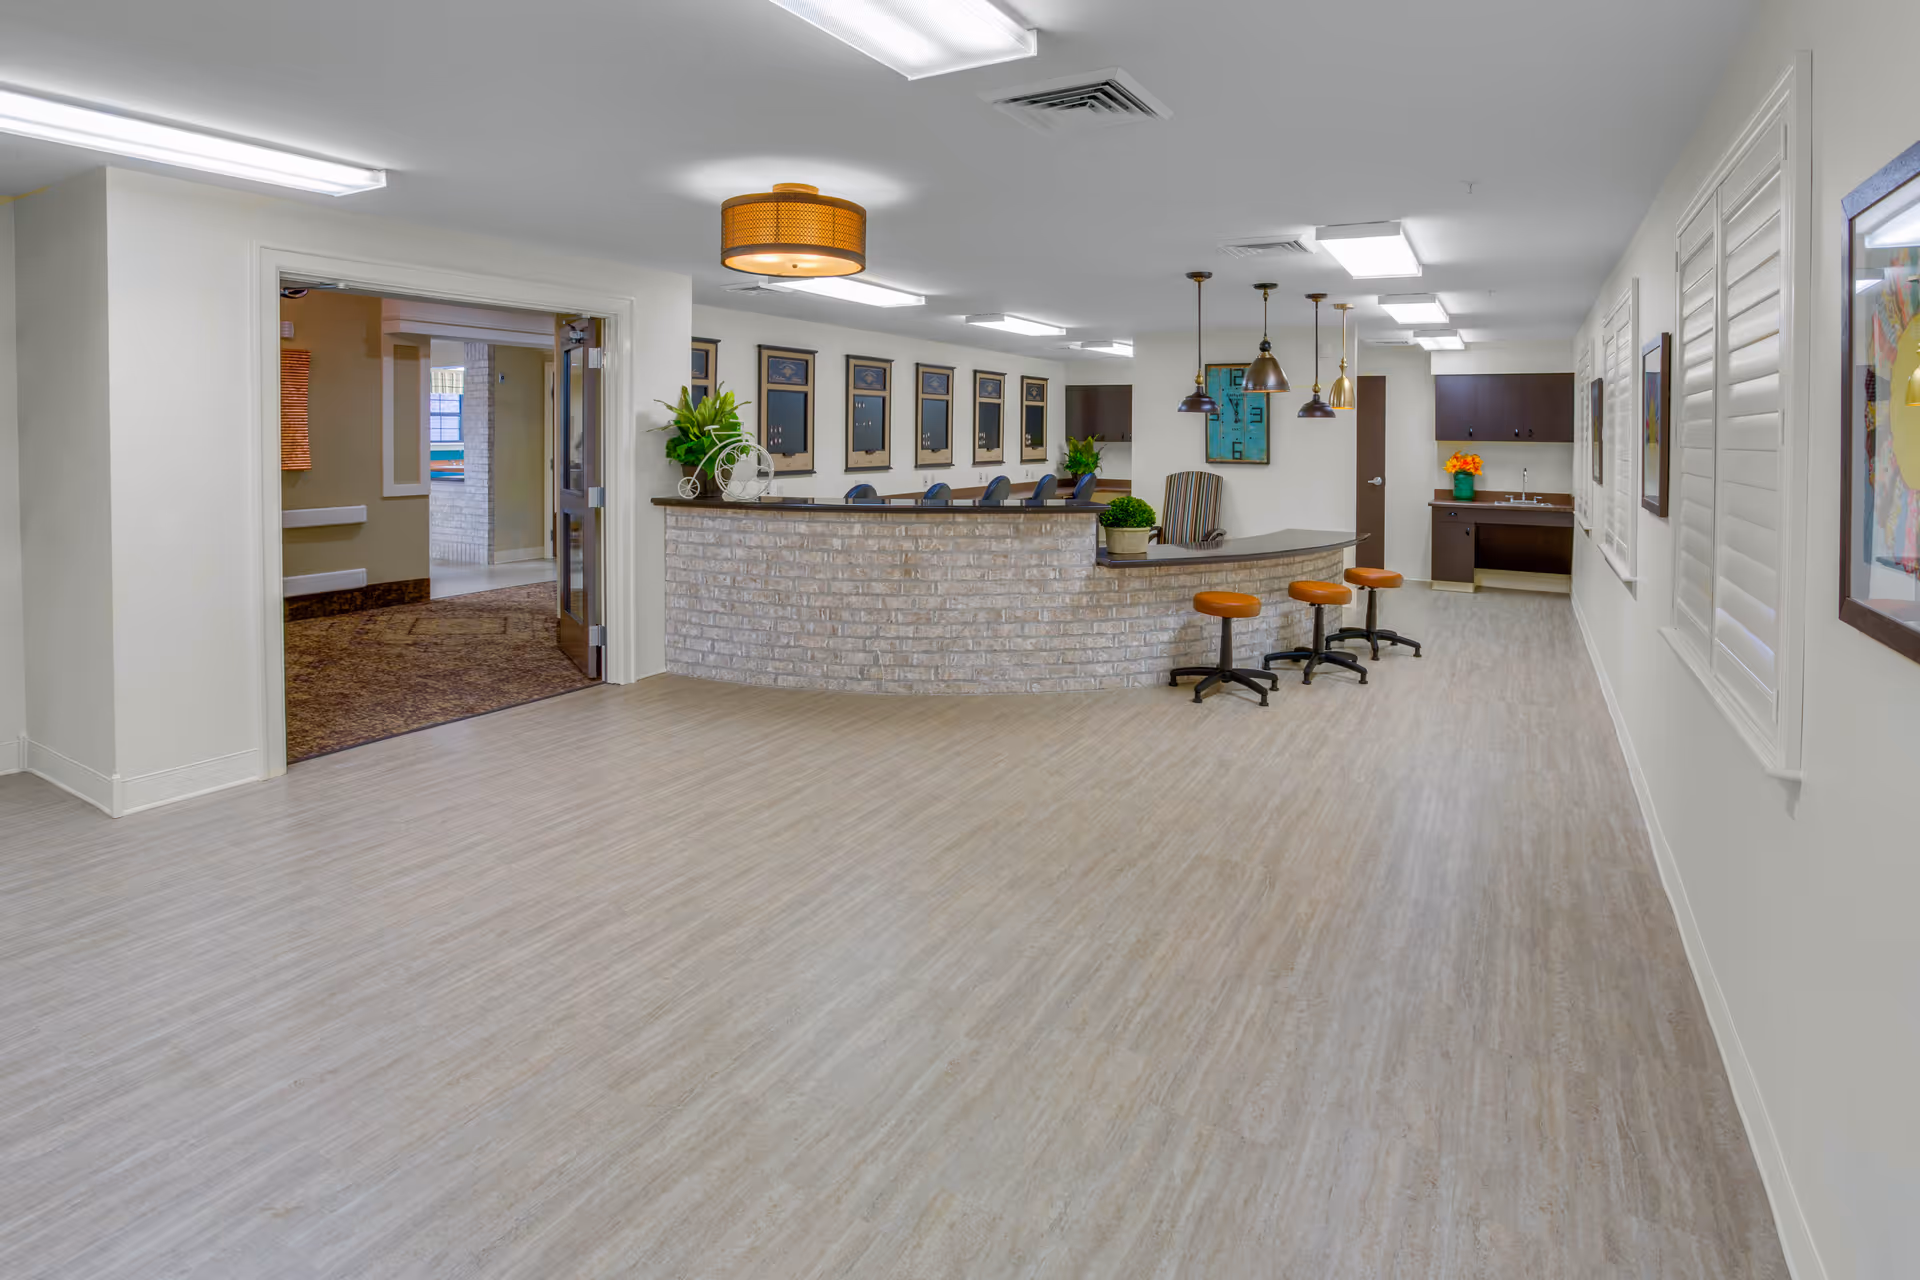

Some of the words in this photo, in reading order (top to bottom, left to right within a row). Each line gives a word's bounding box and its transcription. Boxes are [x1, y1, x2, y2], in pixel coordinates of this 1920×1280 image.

[1230, 368, 1245, 387] 12
[1251, 407, 1262, 423] 3
[1232, 442, 1243, 460] 6
